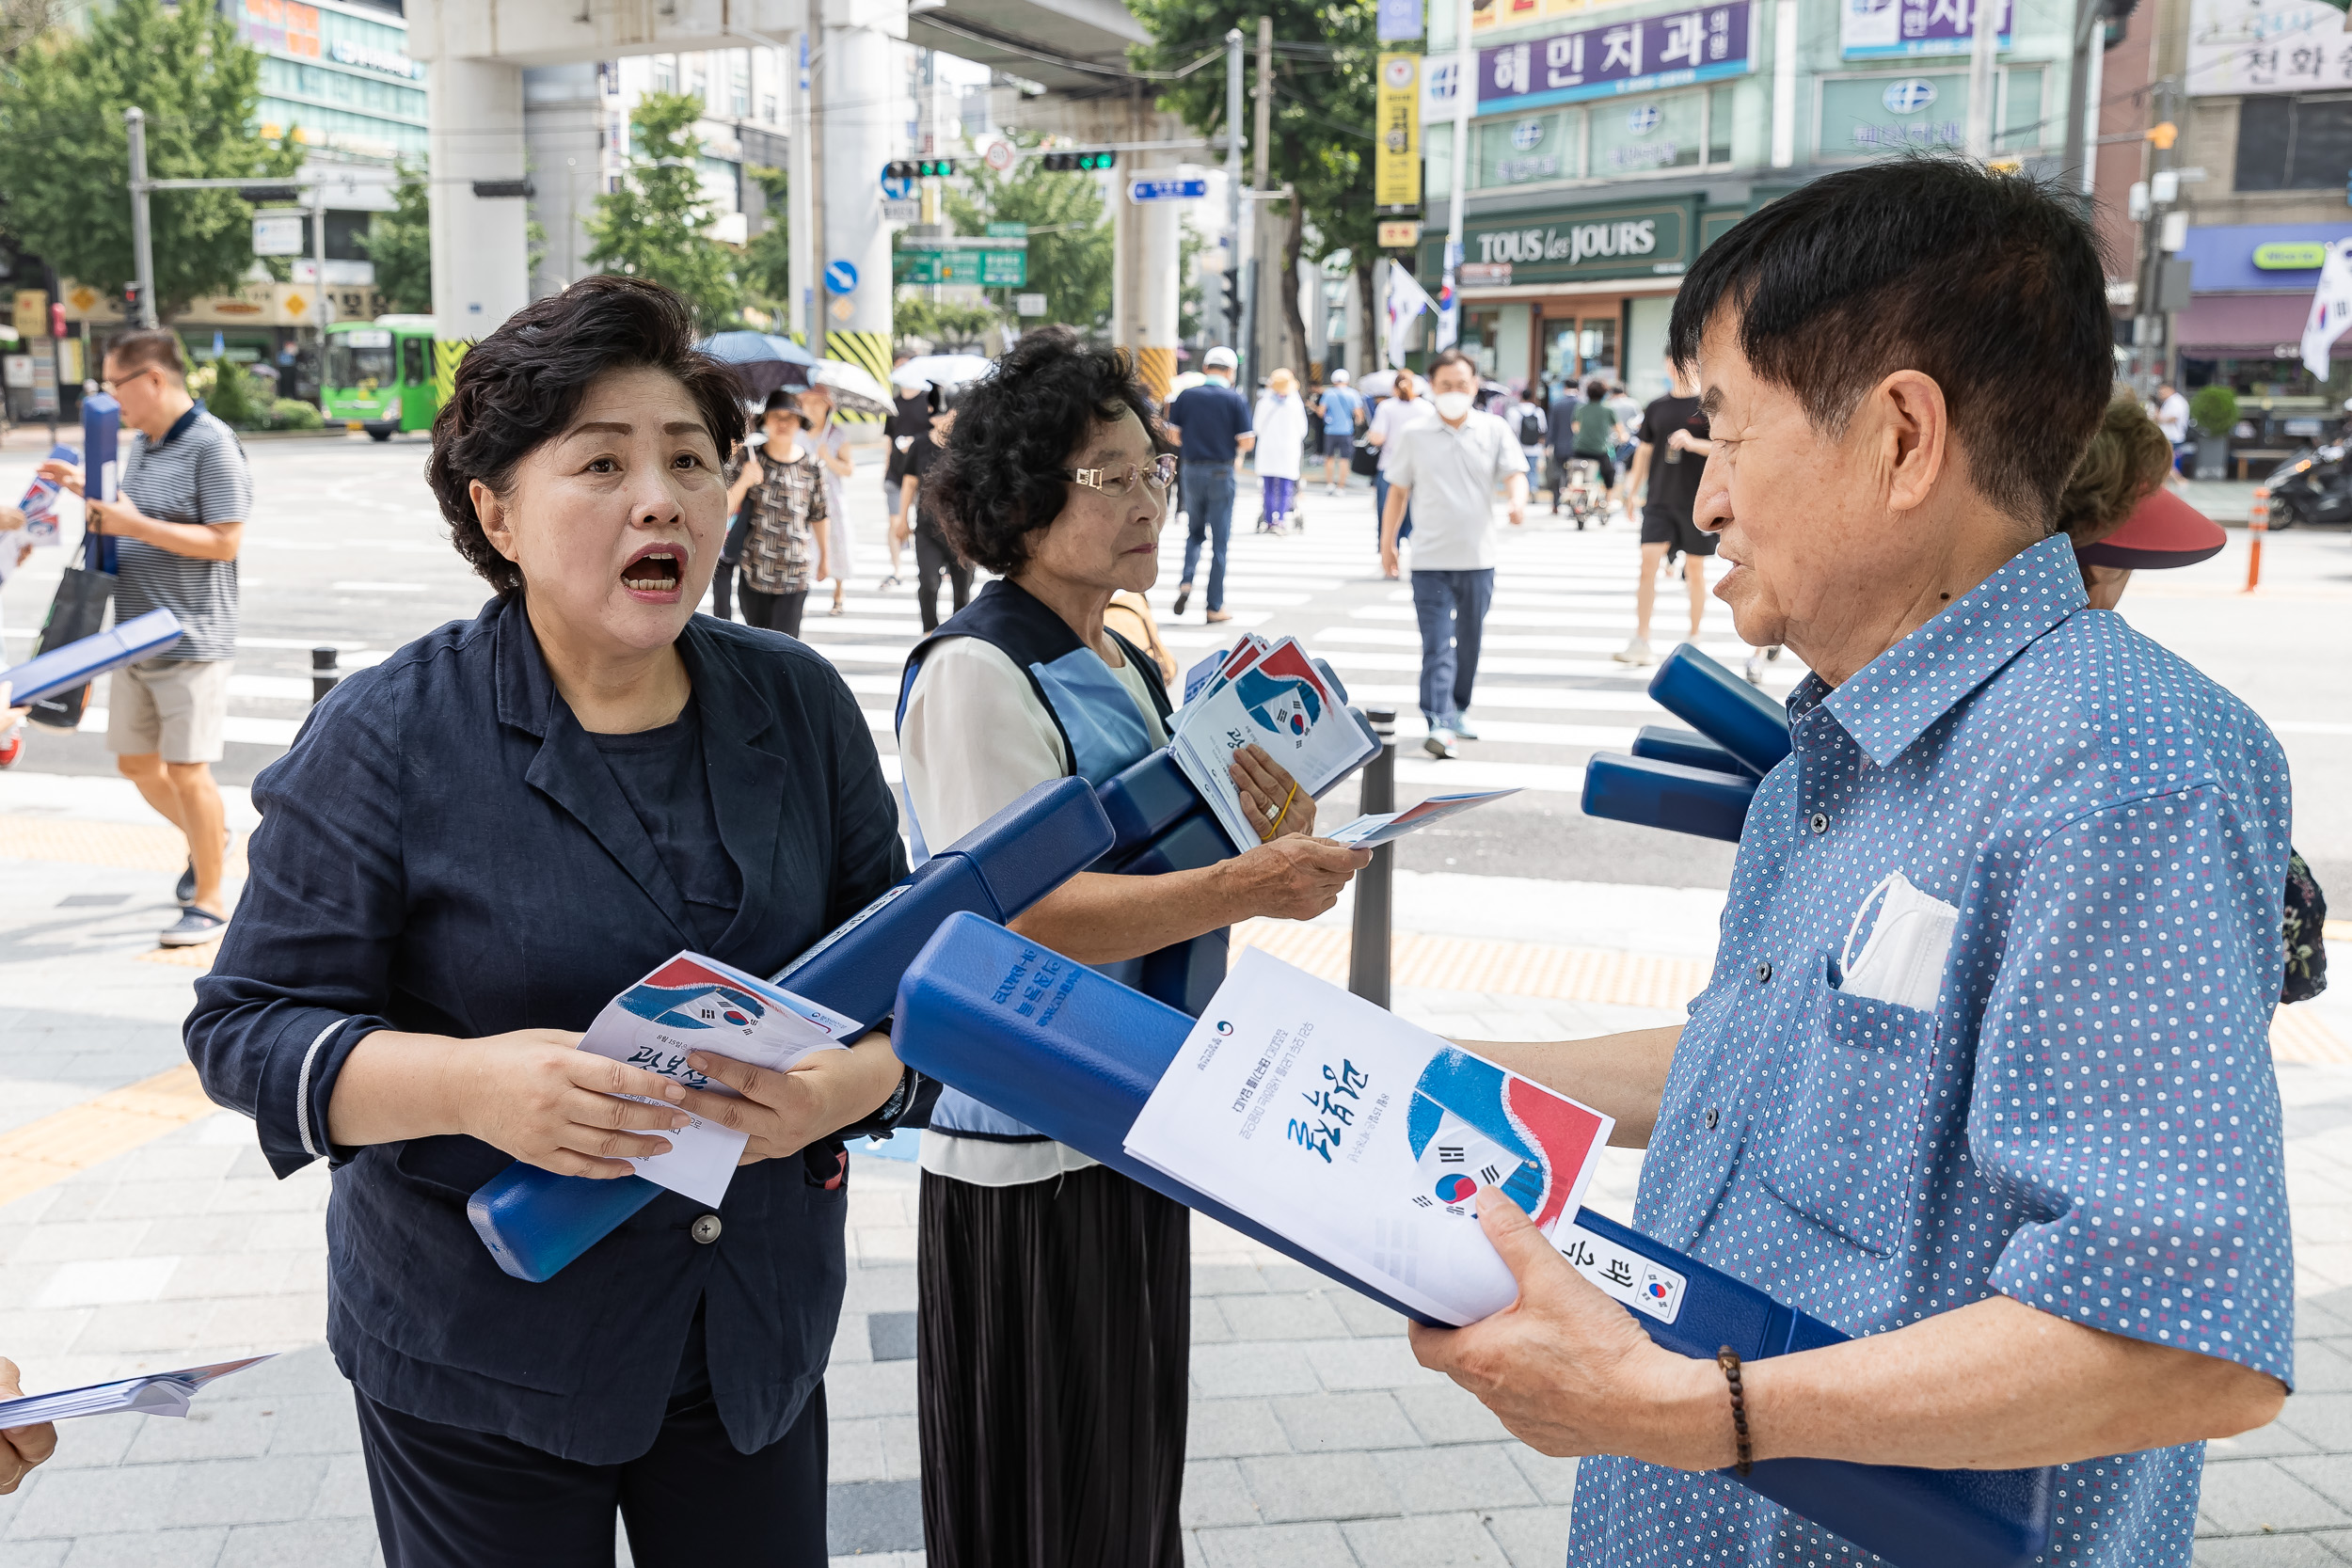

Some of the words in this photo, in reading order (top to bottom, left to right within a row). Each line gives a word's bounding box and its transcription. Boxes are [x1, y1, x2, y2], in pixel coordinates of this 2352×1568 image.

[1477, 229, 1544, 263] TOUS
[1544, 226, 1571, 261] les
[1569, 219, 1656, 265] JOURS
[656, 1033, 669, 1043] 8월
[1263, 1027, 1288, 1060] 집집마다
[1296, 1021, 1314, 1038] 우리
[1197, 1037, 1222, 1071] 행정안전부
[1288, 1036, 1305, 1054] 모두
[1245, 1056, 1271, 1089] 태극기를
[1274, 1052, 1295, 1077] 나라를
[1231, 1086, 1253, 1113] 답시다
[1256, 1074, 1282, 1106] 사랑하는
[1375, 1092, 1390, 1107] 8월
[1237, 1104, 1265, 1140] 마음으로
[1287, 1057, 1370, 1164] 광복절
[1363, 1105, 1383, 1129] 15일은
